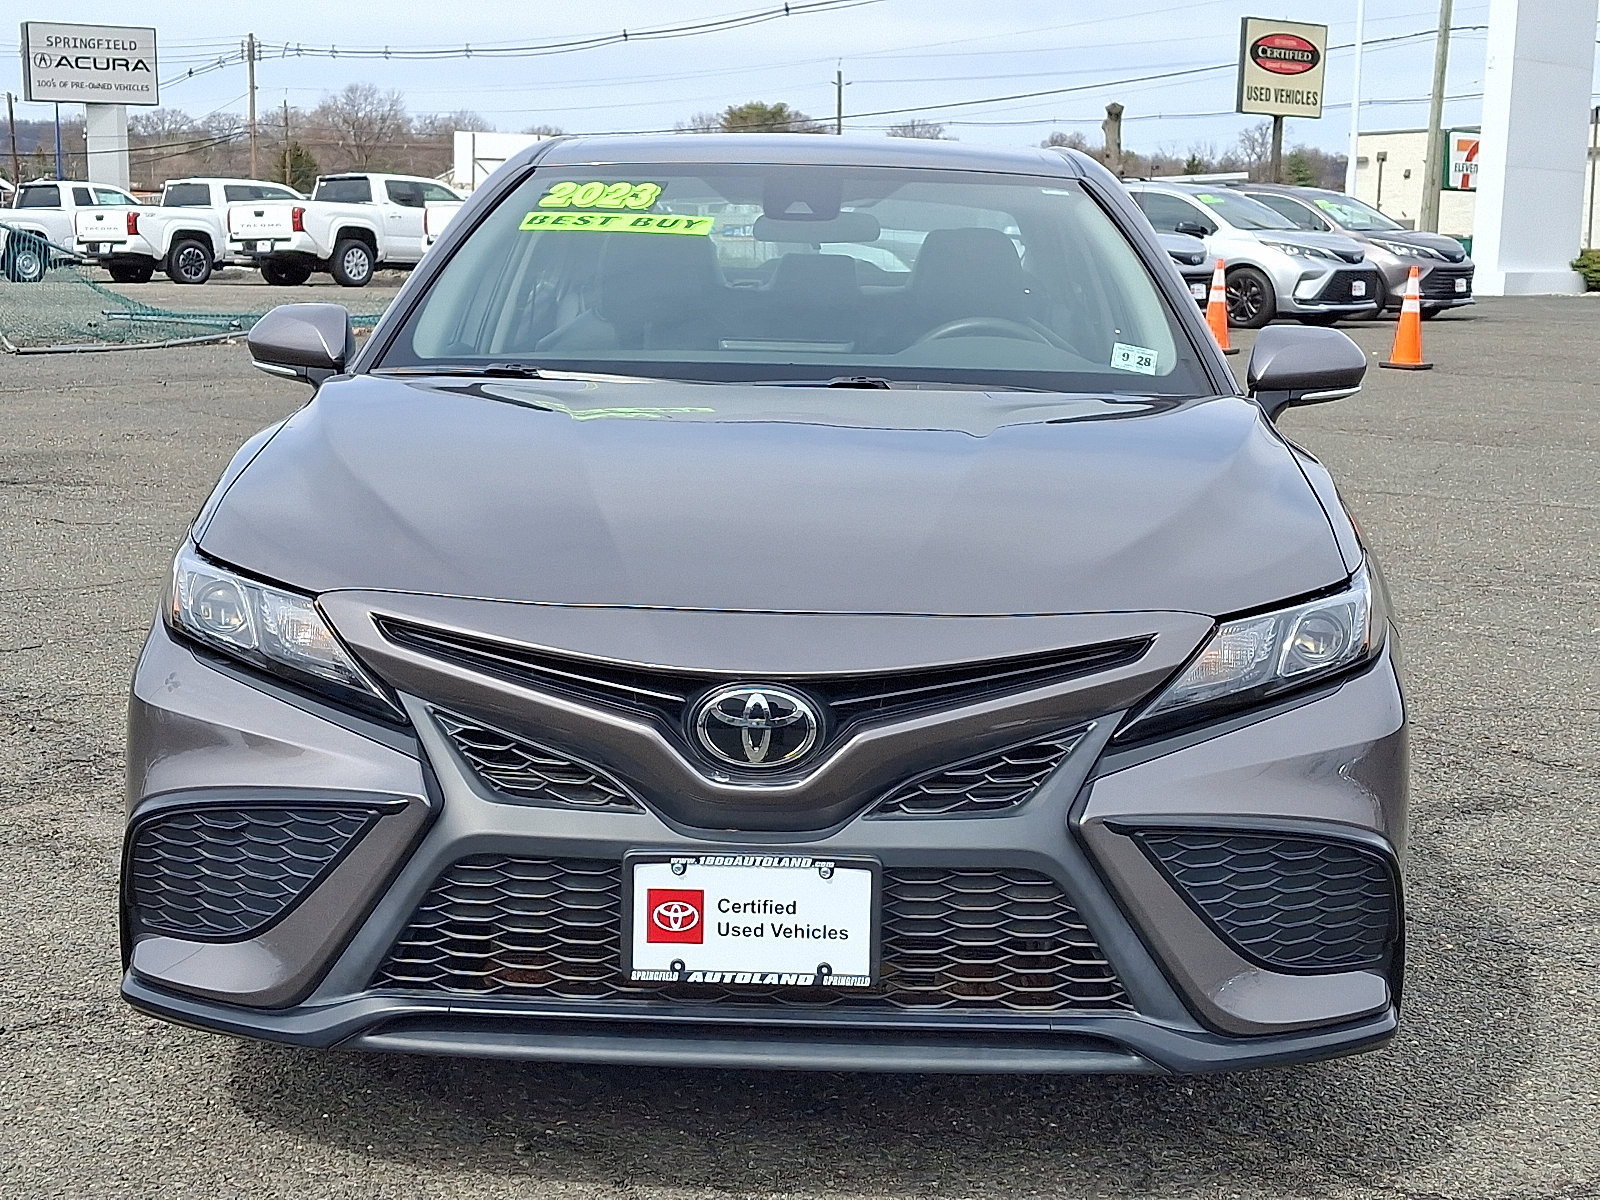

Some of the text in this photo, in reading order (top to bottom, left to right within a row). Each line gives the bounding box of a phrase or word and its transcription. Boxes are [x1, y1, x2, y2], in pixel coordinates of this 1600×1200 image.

[46, 35, 137, 51] SPRINGFIELD
[1257, 46, 1312, 61] CERTIFIED
[54, 55, 152, 73] ACURA
[59, 80, 68, 88] OF
[70, 80, 113, 91] PRE-OWNED
[114, 83, 150, 92] VEHICLES
[1246, 85, 1319, 106] USED VEHICLES
[1456, 139, 1480, 189] 7
[538, 181, 662, 210] 2023
[526, 215, 706, 229] BEST BUY
[1122, 353, 1129, 361] 9
[1136, 356, 1151, 367] 28
[717, 898, 797, 915] Certified
[717, 921, 849, 941] Used Vehicles
[631, 970, 871, 988] SPRINGFIELD AUTOLAND SPRINGFIELD
